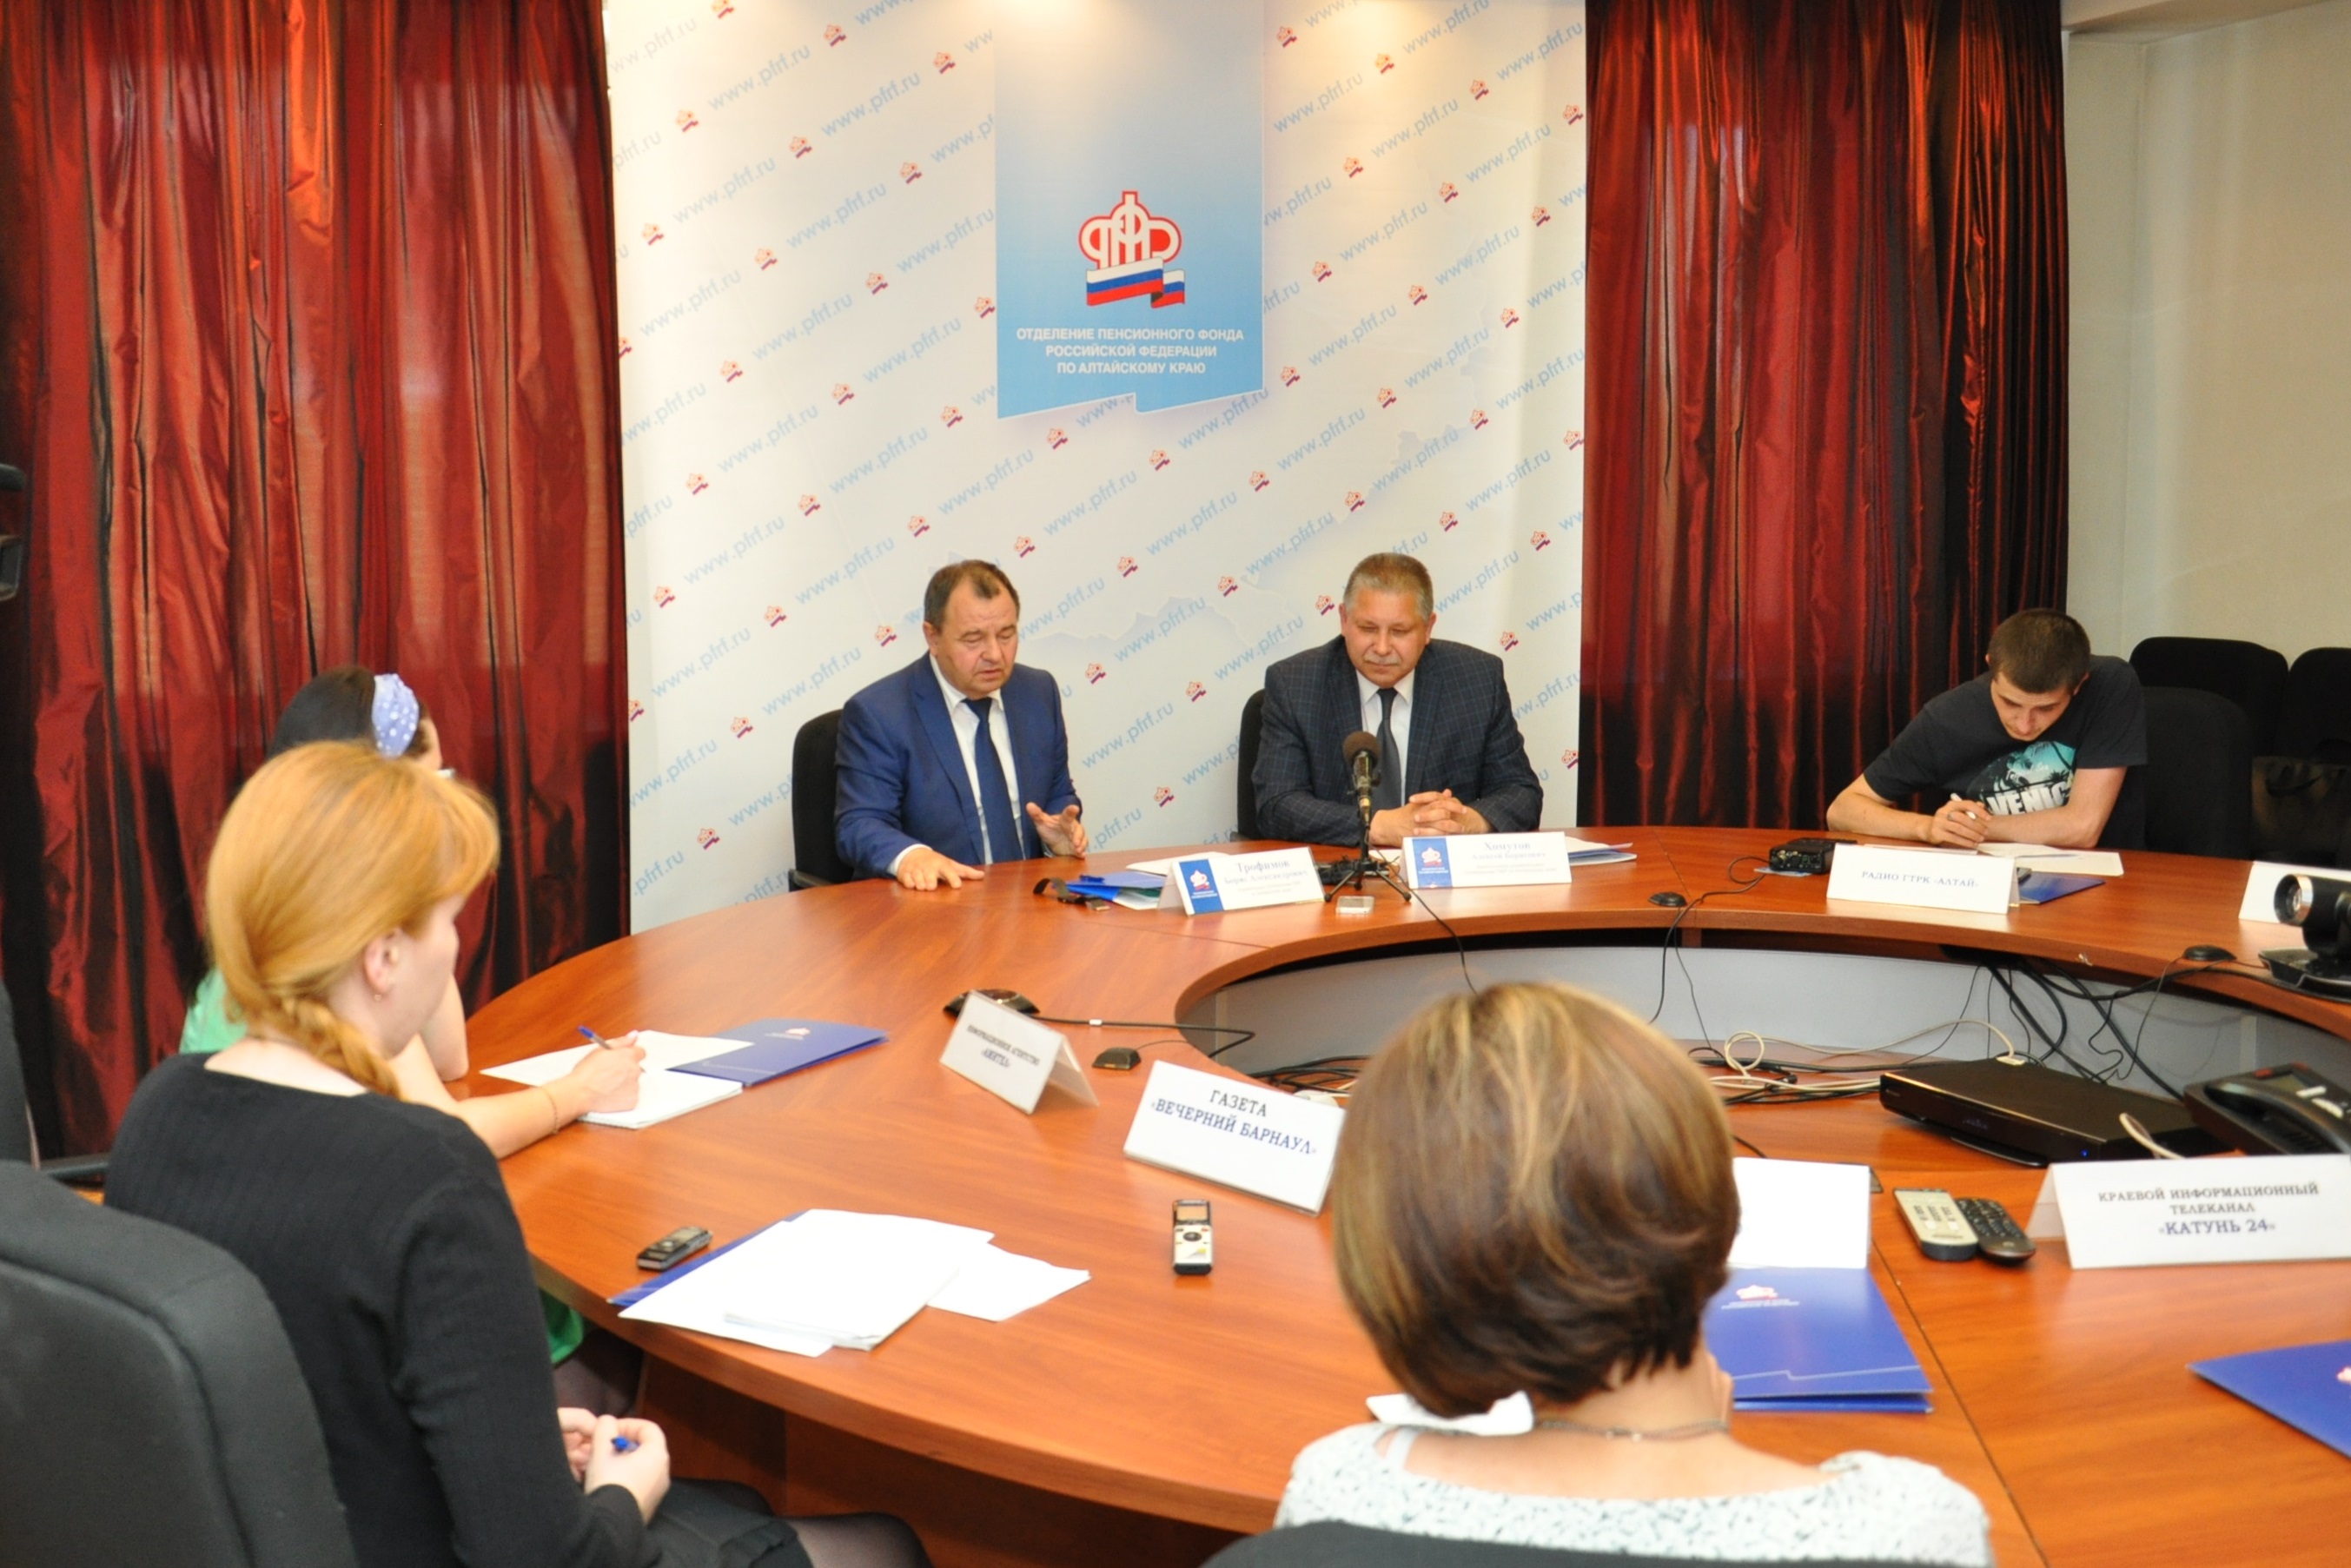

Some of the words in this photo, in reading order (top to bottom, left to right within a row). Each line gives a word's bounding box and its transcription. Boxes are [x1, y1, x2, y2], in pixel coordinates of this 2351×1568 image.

[1402, 0, 1491, 56] www.pfrf.ru
[1496, 20, 1585, 82] www.pfrf.ru
[707, 44, 811, 112] www.pfrf.ru
[820, 71, 921, 137] www.pfrf.ru
[1273, 72, 1364, 133] www.pfrf.ru
[1370, 98, 1460, 159] www.pfrf.ru
[1466, 123, 1552, 183] www.pfrf.ru
[672, 156, 777, 225] www.pfrf.ru
[785, 182, 888, 250] www.pfrf.ru
[896, 209, 995, 275] www.pfrf.ru
[1340, 201, 1428, 261] www.pfrf.ru
[1435, 225, 1520, 286] www.pfrf.ru
[639, 269, 742, 337] www.pfrf.ru
[752, 291, 853, 362] www.pfrf.ru
[1017, 327, 1095, 341] ОТДЕЛЕНИЕ
[1098, 328, 1195, 341] ПЕНСИОННОГО
[1198, 328, 1244, 341] ФОНДА
[862, 317, 962, 385] www.pfrf.ru
[1045, 343, 1136, 357] РОССИЙСКОЙ
[1139, 345, 1217, 358] ФЕДЕРАЦИИ
[1057, 362, 1076, 374] ПО
[1078, 361, 1166, 374] АЛТАЙСКОМУ
[1169, 362, 1206, 374] КРАЮ
[1308, 304, 1398, 367] www.pfrf.ru
[1404, 327, 1490, 389] www.pfrf.ru
[1495, 347, 1585, 410] www.pfrf.ru
[718, 404, 820, 473] www.pfrf.ru
[1177, 388, 1270, 451] www.pfrf.ru
[1277, 407, 1366, 472] www.pfrf.ru
[829, 427, 929, 495] www.pfrf.ru
[938, 447, 1035, 516] www.pfrf.ru
[1372, 429, 1460, 492] www.pfrf.ru
[1466, 449, 1552, 513] www.pfrf.ru
[1043, 470, 1138, 536] www.pfrf.ru
[1145, 491, 1238, 557] www.pfrf.ru
[684, 515, 786, 586] www.pfrf.ru
[795, 537, 897, 606] www.pfrf.ru
[1245, 511, 1334, 577] www.pfrf.ru
[1435, 550, 1520, 613] www.pfrf.ru
[1113, 596, 1206, 663] www.pfrf.ru
[1215, 615, 1306, 680] www.pfrf.ru
[651, 626, 752, 698] www.pfrf.ru
[762, 646, 863, 718] www.pfrf.ru
[1080, 702, 1174, 770] www.pfrf.ru
[1236, 859, 1290, 876] Трофимов
[1483, 842, 1531, 853] Хомутов
[1862, 870, 1899, 882] РАДИО
[1903, 874, 1930, 883] ГТРК
[1209, 1089, 1268, 1117] ГАЗЕТА
[2098, 1188, 2165, 1202] КРАЕВОЙ
[2170, 1181, 2319, 1200] ИНФОРМАЦИОННЫЙ
[2169, 1202, 2255, 1215] ТЕЛЕКАНАЛ
